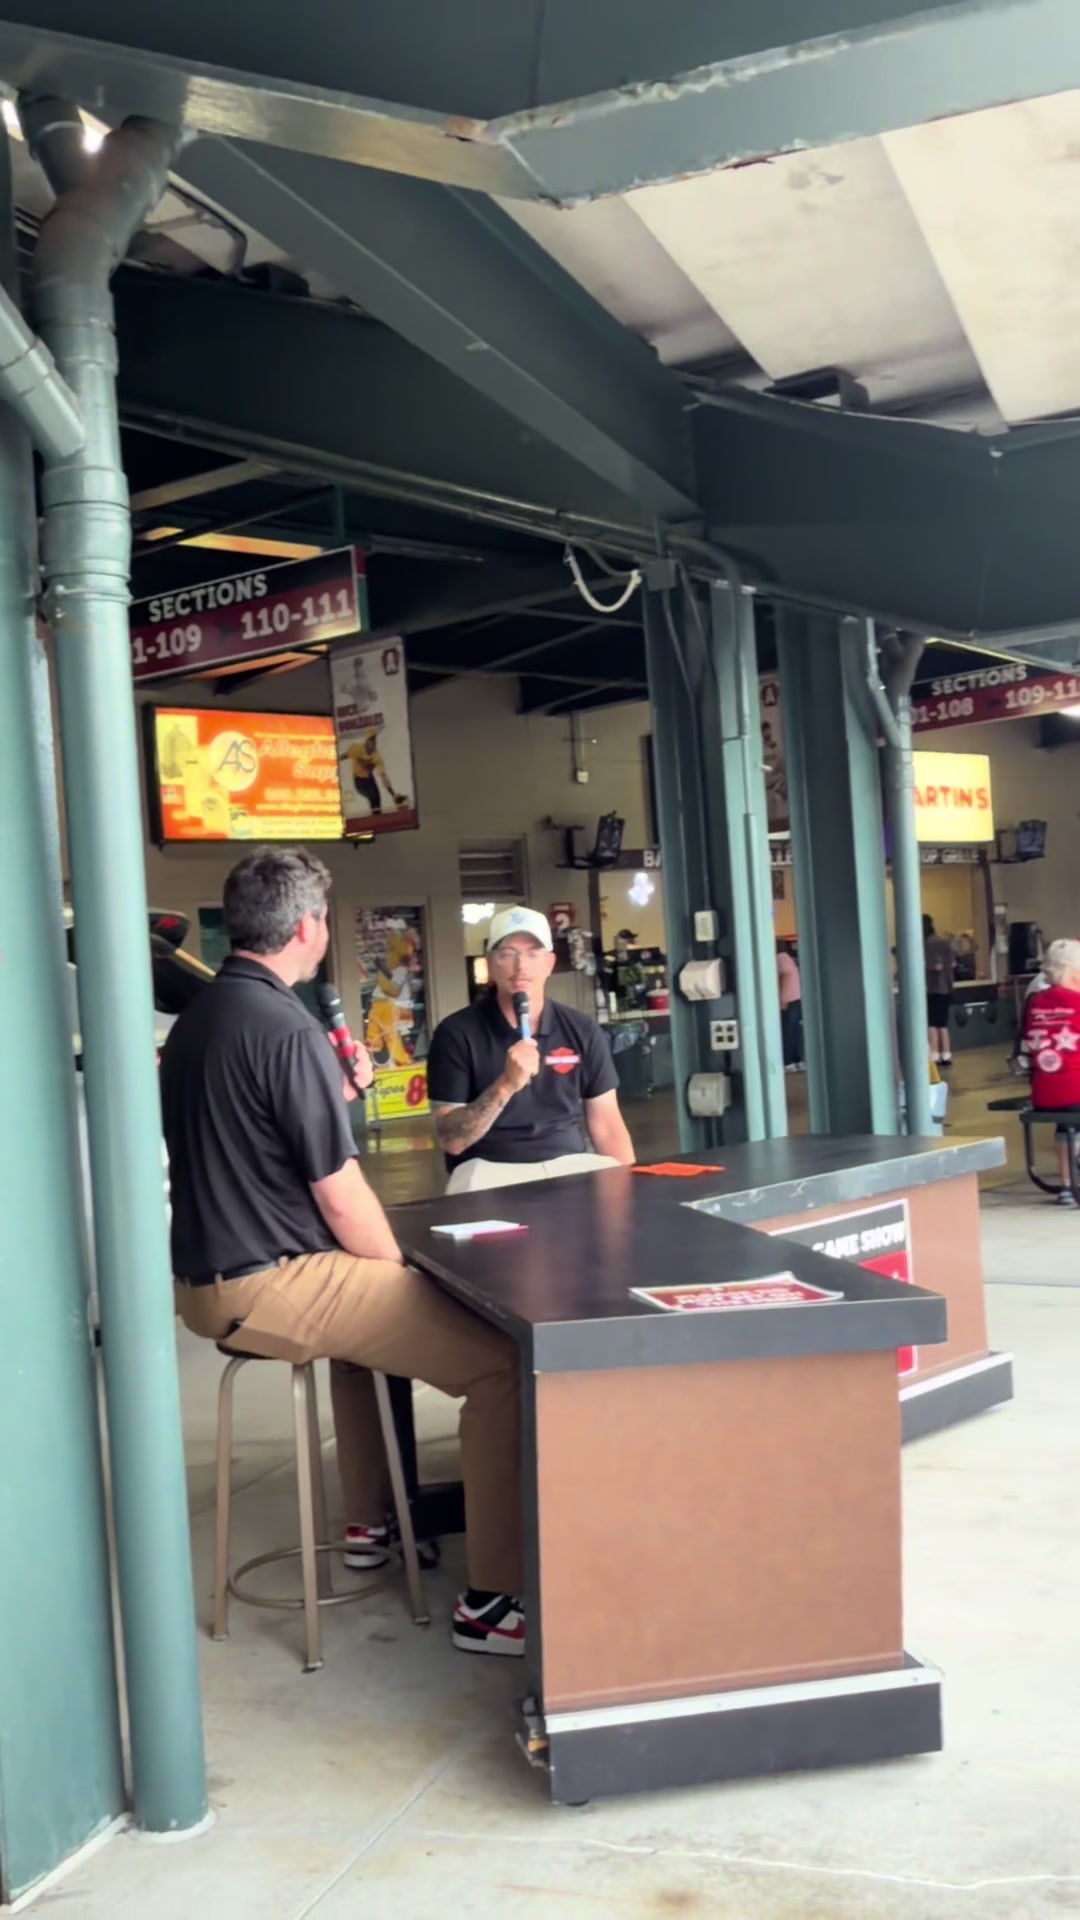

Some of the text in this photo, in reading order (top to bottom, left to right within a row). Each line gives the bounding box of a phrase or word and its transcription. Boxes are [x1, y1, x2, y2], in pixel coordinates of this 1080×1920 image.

[149, 574, 268, 622] SECTIONS
[241, 588, 353, 640] 110-111
[931, 664, 1028, 697] SECTIONS
[860, 1221, 905, 1252] SHOW
